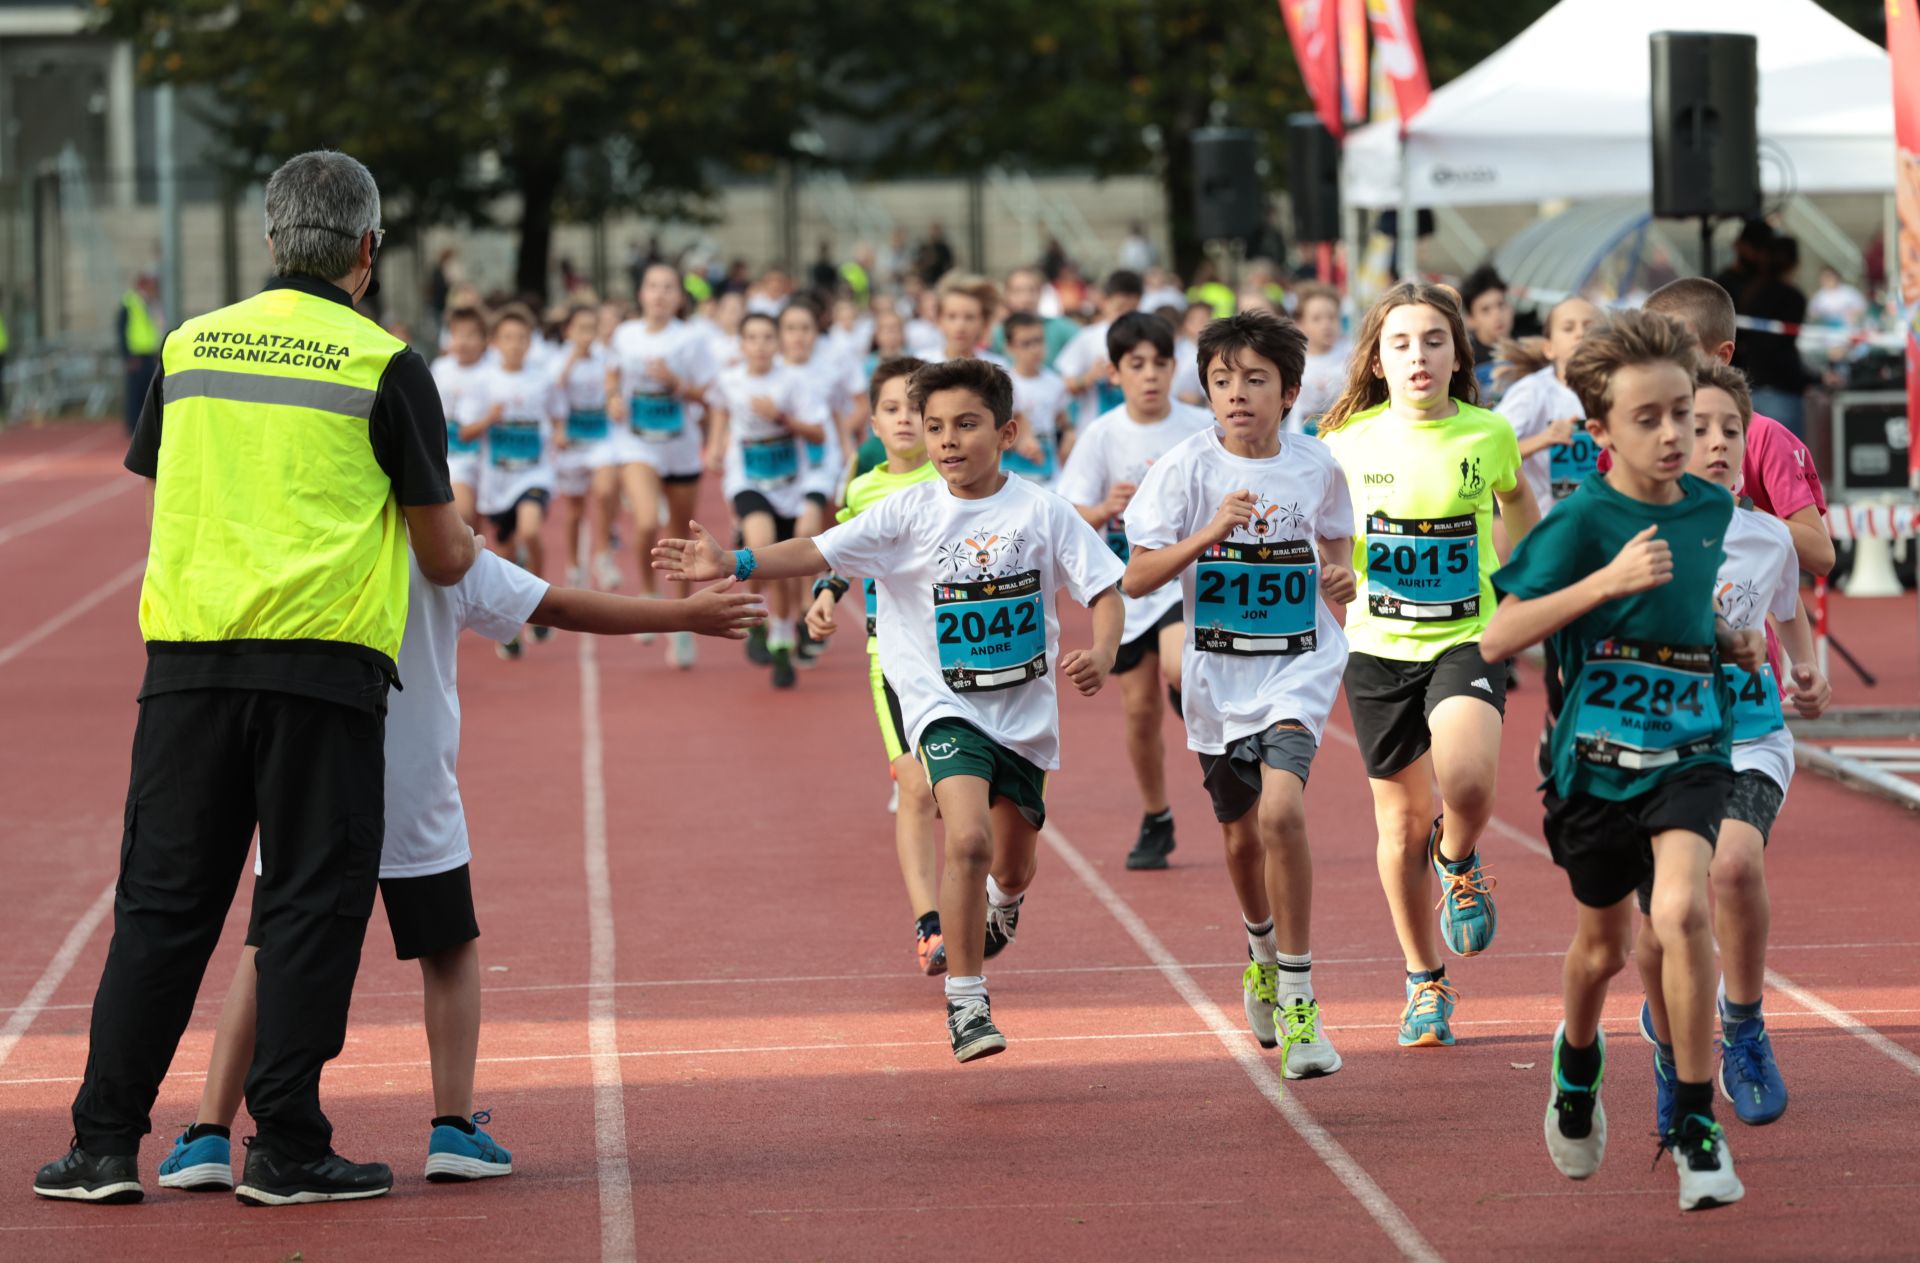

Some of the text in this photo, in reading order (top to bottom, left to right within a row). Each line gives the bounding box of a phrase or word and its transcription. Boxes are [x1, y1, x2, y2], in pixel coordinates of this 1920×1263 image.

[193, 331, 350, 357] ANTOLATZAILEA
[193, 345, 341, 371] ORGANIZACIÓN
[1369, 542, 1469, 576] 2015
[1198, 570, 1306, 607] 2150
[1397, 577, 1442, 588] AURITZ
[937, 601, 1037, 644] 2042
[1241, 609, 1268, 620] JON
[970, 641, 1012, 656] ANDRE
[1585, 668, 1703, 718] 2284
[1621, 716, 1673, 733] MAURO
